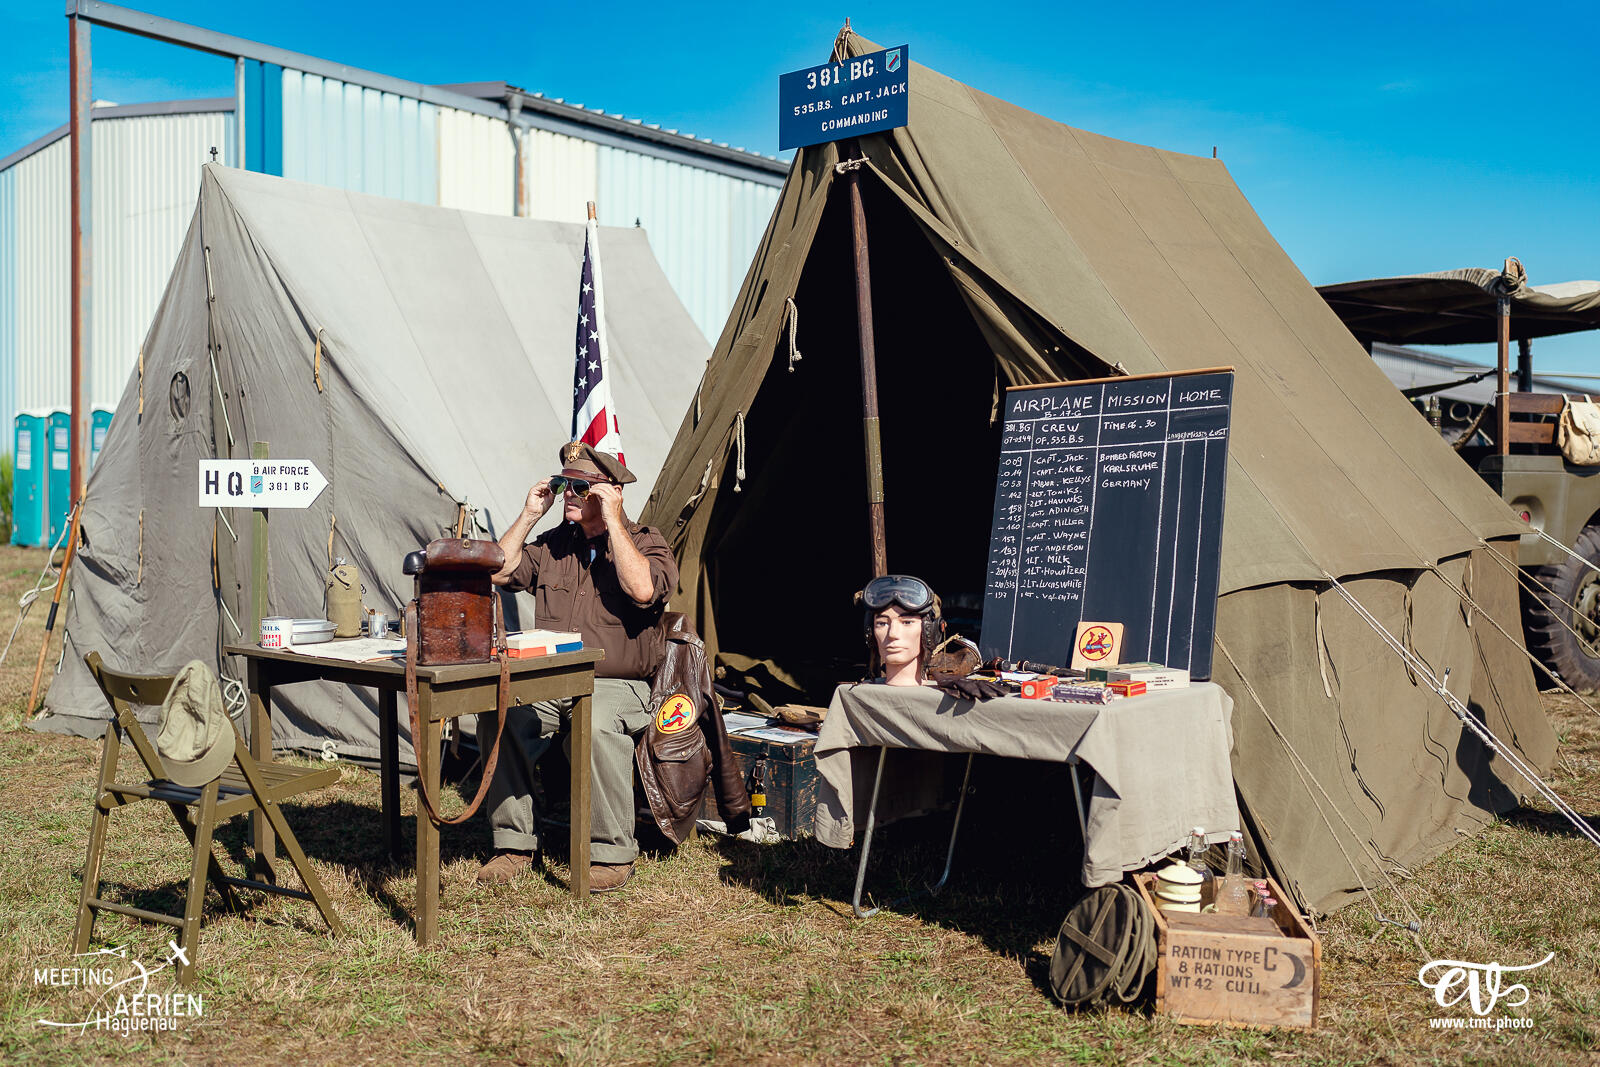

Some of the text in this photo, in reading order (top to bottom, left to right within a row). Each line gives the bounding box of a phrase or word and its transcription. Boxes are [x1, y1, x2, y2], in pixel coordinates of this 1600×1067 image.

[876, 82, 906, 98] JACK
[821, 109, 888, 131] COMMANDING
[1107, 393, 1167, 408] MISSION
[1179, 389, 1221, 403] HOME
[1013, 396, 1093, 412] AIRPLANE
[1041, 423, 1080, 433] CREW
[253, 466, 309, 475] 8 AIR FORCE
[1103, 461, 1158, 473] KARLSRUHE
[268, 482, 309, 491] 381 BG
[1102, 478, 1151, 491] GERMANY
[1053, 531, 1087, 541] WAYNE
[1172, 945, 1278, 971] RATION TYPE C
[1178, 961, 1254, 979] 8 RATIONS
[1171, 975, 1191, 989] WT
[1194, 977, 1213, 991] 42
[1225, 980, 1244, 993] CU
